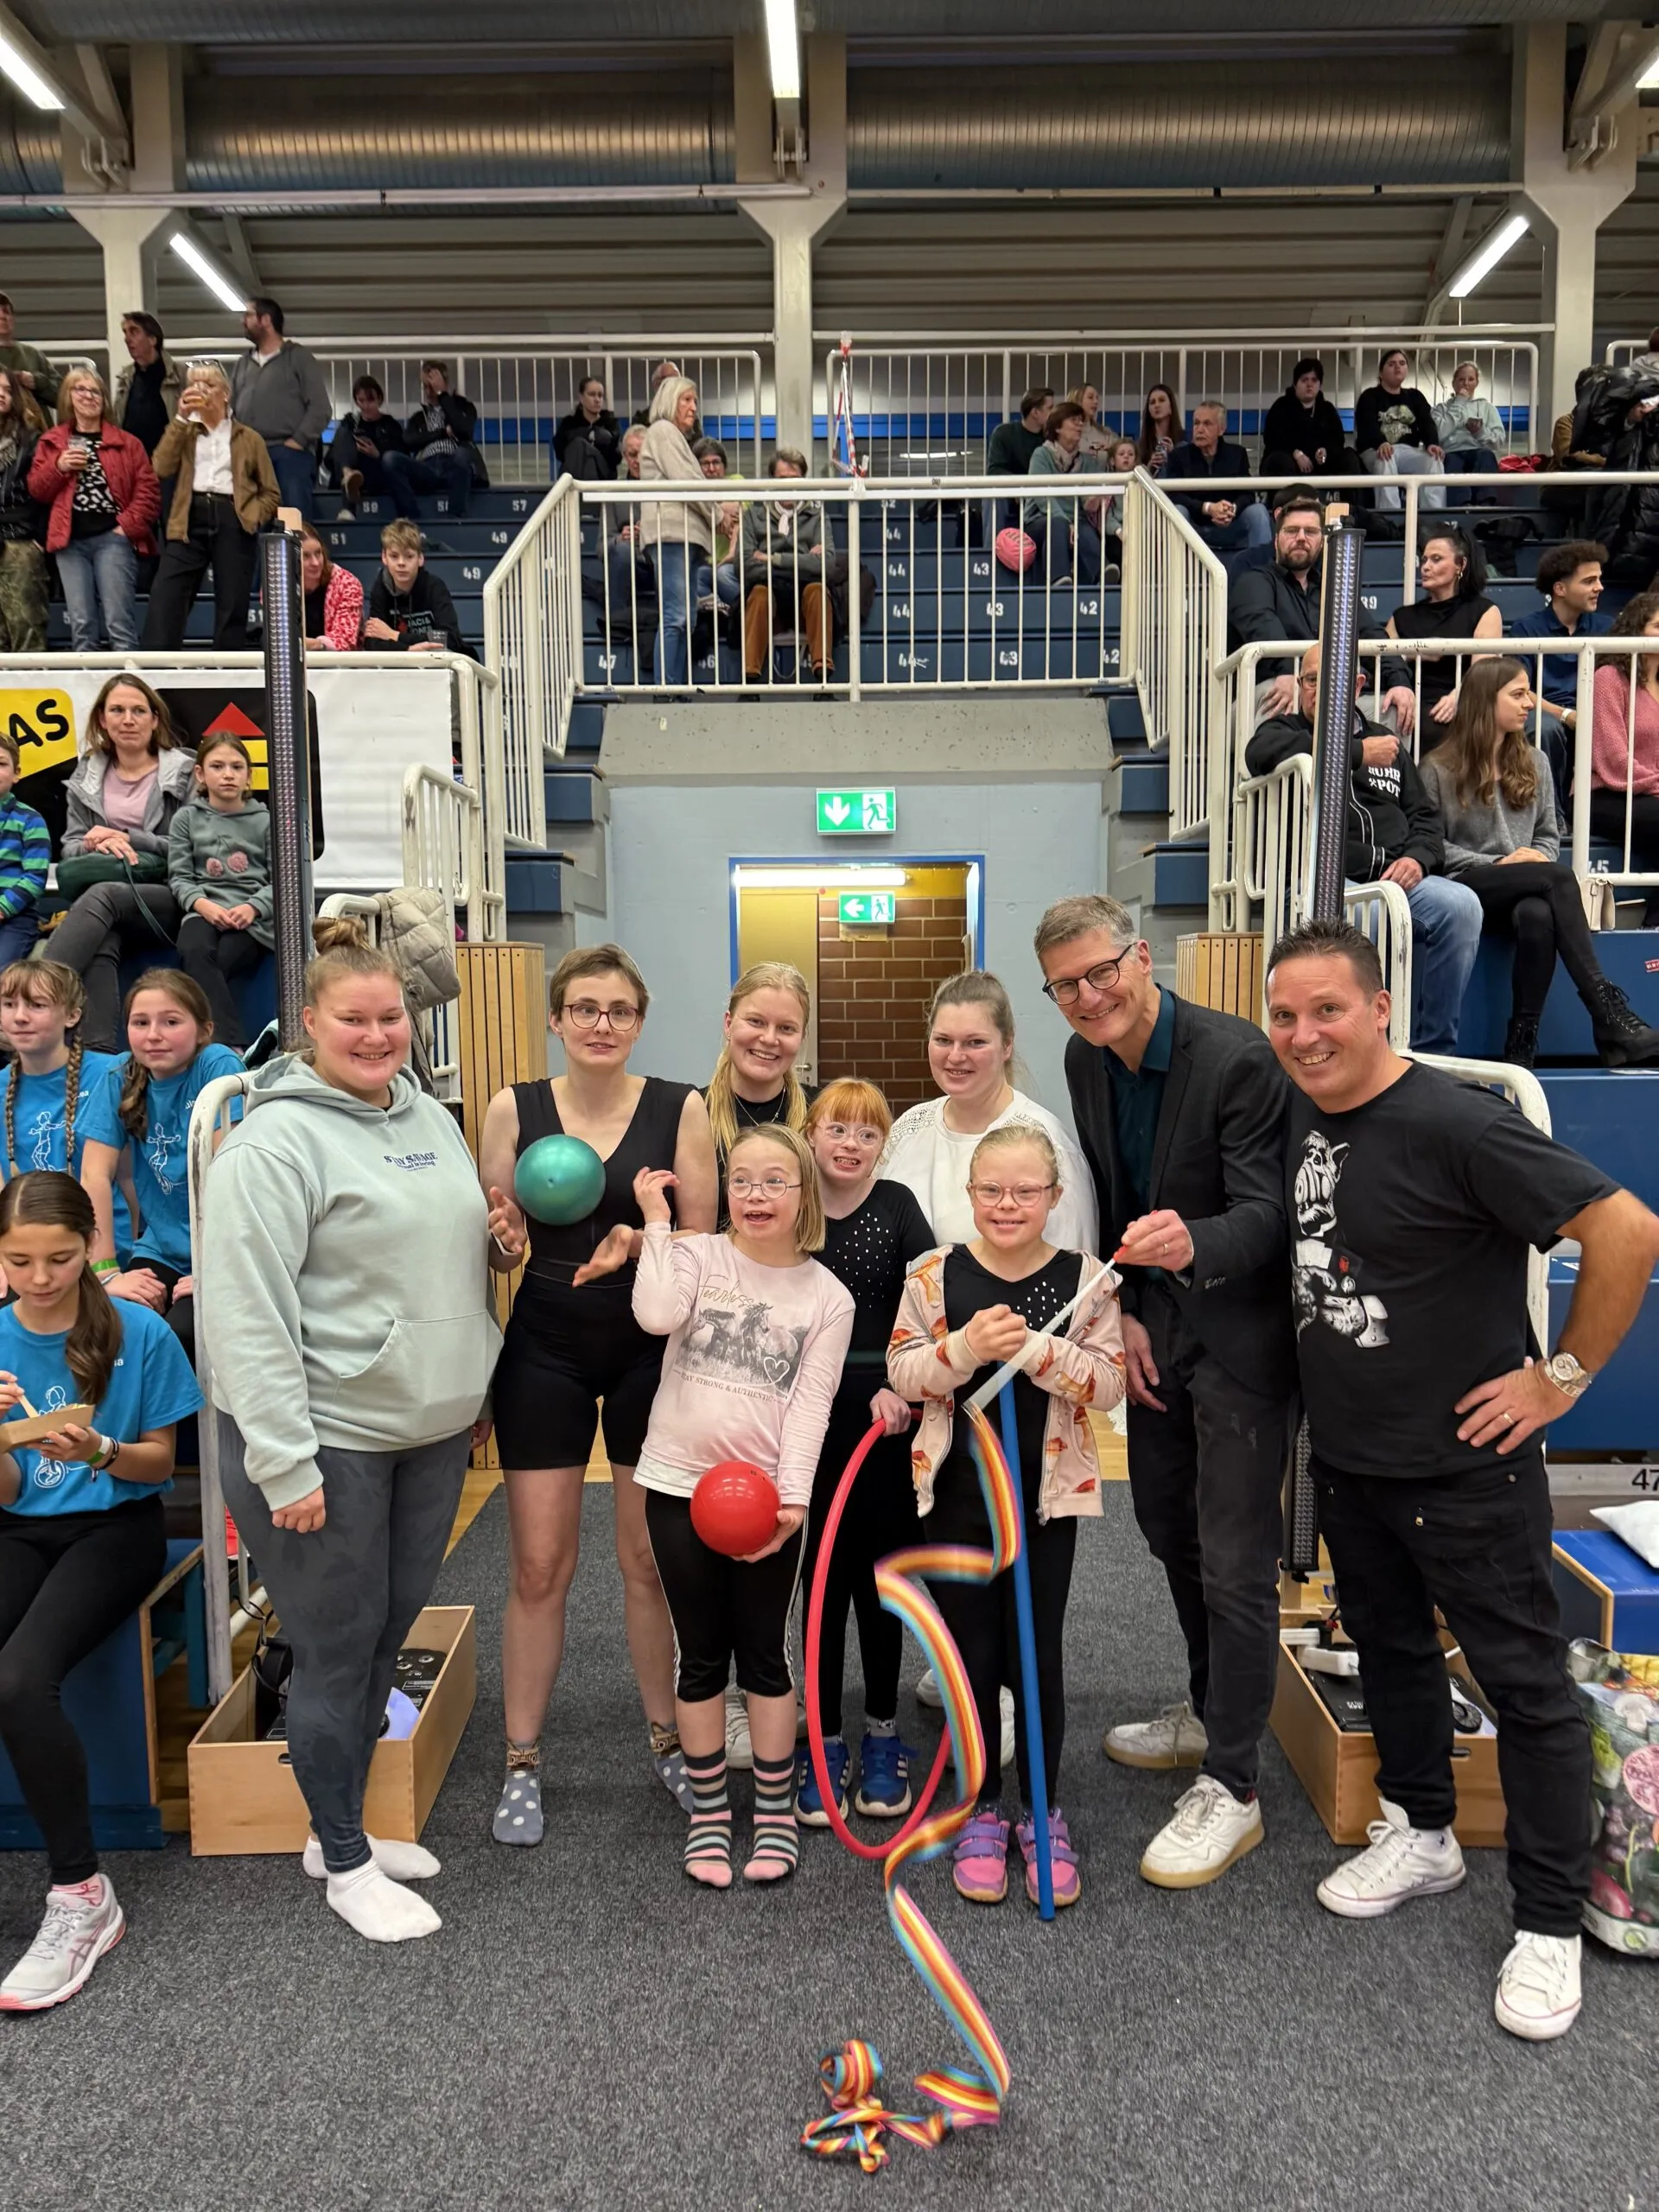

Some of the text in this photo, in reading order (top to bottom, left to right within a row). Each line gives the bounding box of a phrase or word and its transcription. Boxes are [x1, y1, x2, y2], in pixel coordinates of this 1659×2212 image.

[512, 499, 527, 512] 57
[491, 531, 508, 543] 49
[886, 527, 901, 540] 44
[463, 567, 480, 580] 49
[888, 563, 906, 576] 44
[973, 563, 989, 576] 43
[893, 603, 911, 619] 44
[986, 602, 1004, 616] 43
[1079, 601, 1097, 614] 42
[598, 654, 616, 670] 47
[696, 1377, 724, 1391] STRONG
